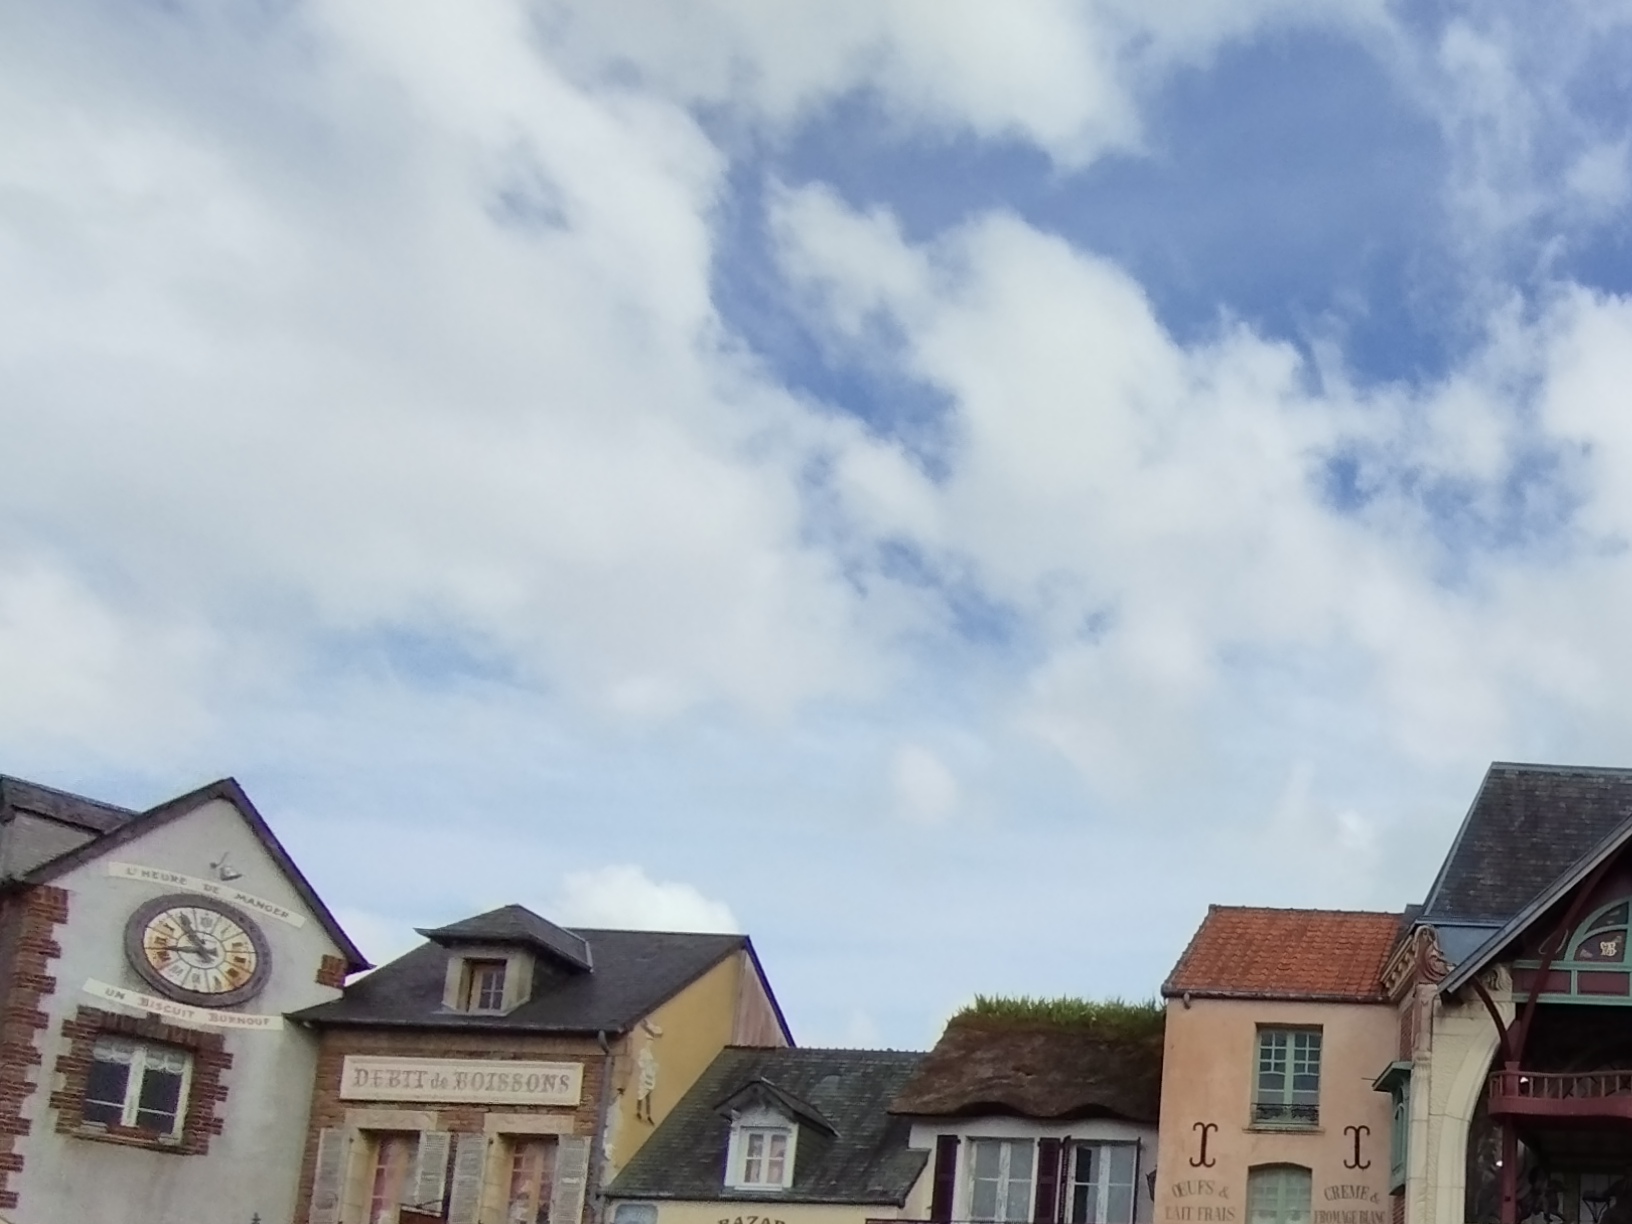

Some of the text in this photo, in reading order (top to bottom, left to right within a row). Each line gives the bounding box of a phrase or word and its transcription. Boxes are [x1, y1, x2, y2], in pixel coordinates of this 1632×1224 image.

[126, 866, 290, 919] L'HEURE DE MANGER
[104, 988, 126, 1000] UN
[140, 997, 195, 1018] BISCUIT
[430, 1072, 448, 1090] de
[453, 1071, 571, 1093] BOISSONS
[1218, 1186, 1230, 1200] &
[1165, 1206, 1236, 1221] LAIT FRAIS
[1314, 1210, 1386, 1224] FROMAGE BLANC
